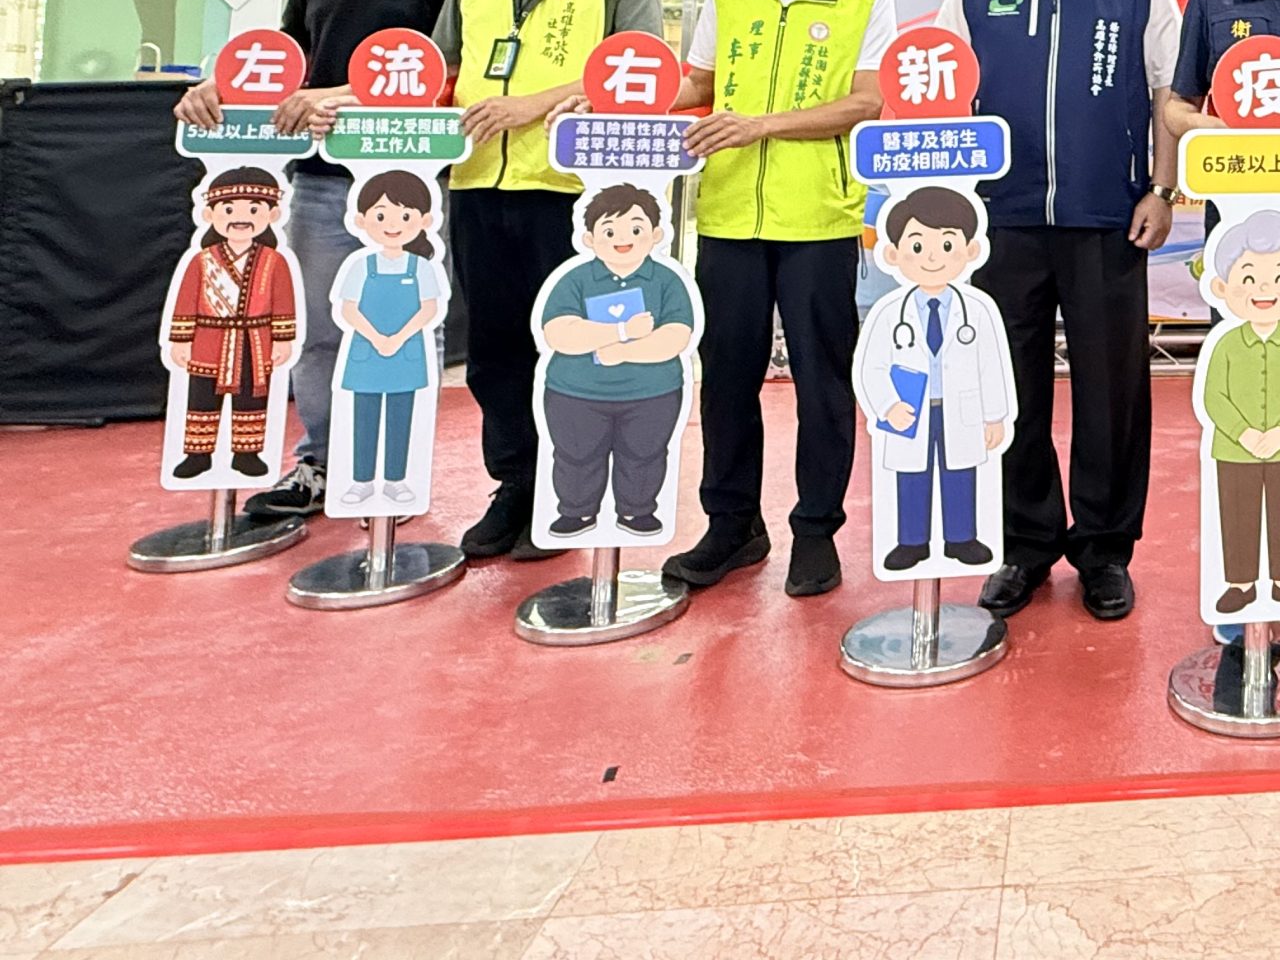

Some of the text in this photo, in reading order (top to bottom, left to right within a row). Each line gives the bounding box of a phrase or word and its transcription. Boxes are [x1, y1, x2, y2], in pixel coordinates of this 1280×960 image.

[540, 17, 558, 59] 社會局
[1230, 19, 1252, 39] 衛
[230, 42, 288, 93] 左
[367, 43, 427, 97] 流
[603, 47, 662, 106] 右
[896, 42, 958, 105] 新
[332, 117, 460, 136] 長照機構之受照顧者
[575, 120, 682, 138] 高風險慢性病人
[360, 137, 431, 154] 及工作人員
[574, 137, 681, 153] 或罕見疾病患者
[882, 128, 979, 152] 醫事及衛生
[573, 152, 681, 168] 及重大傷病患者
[872, 149, 988, 173] 防疫相關人員
